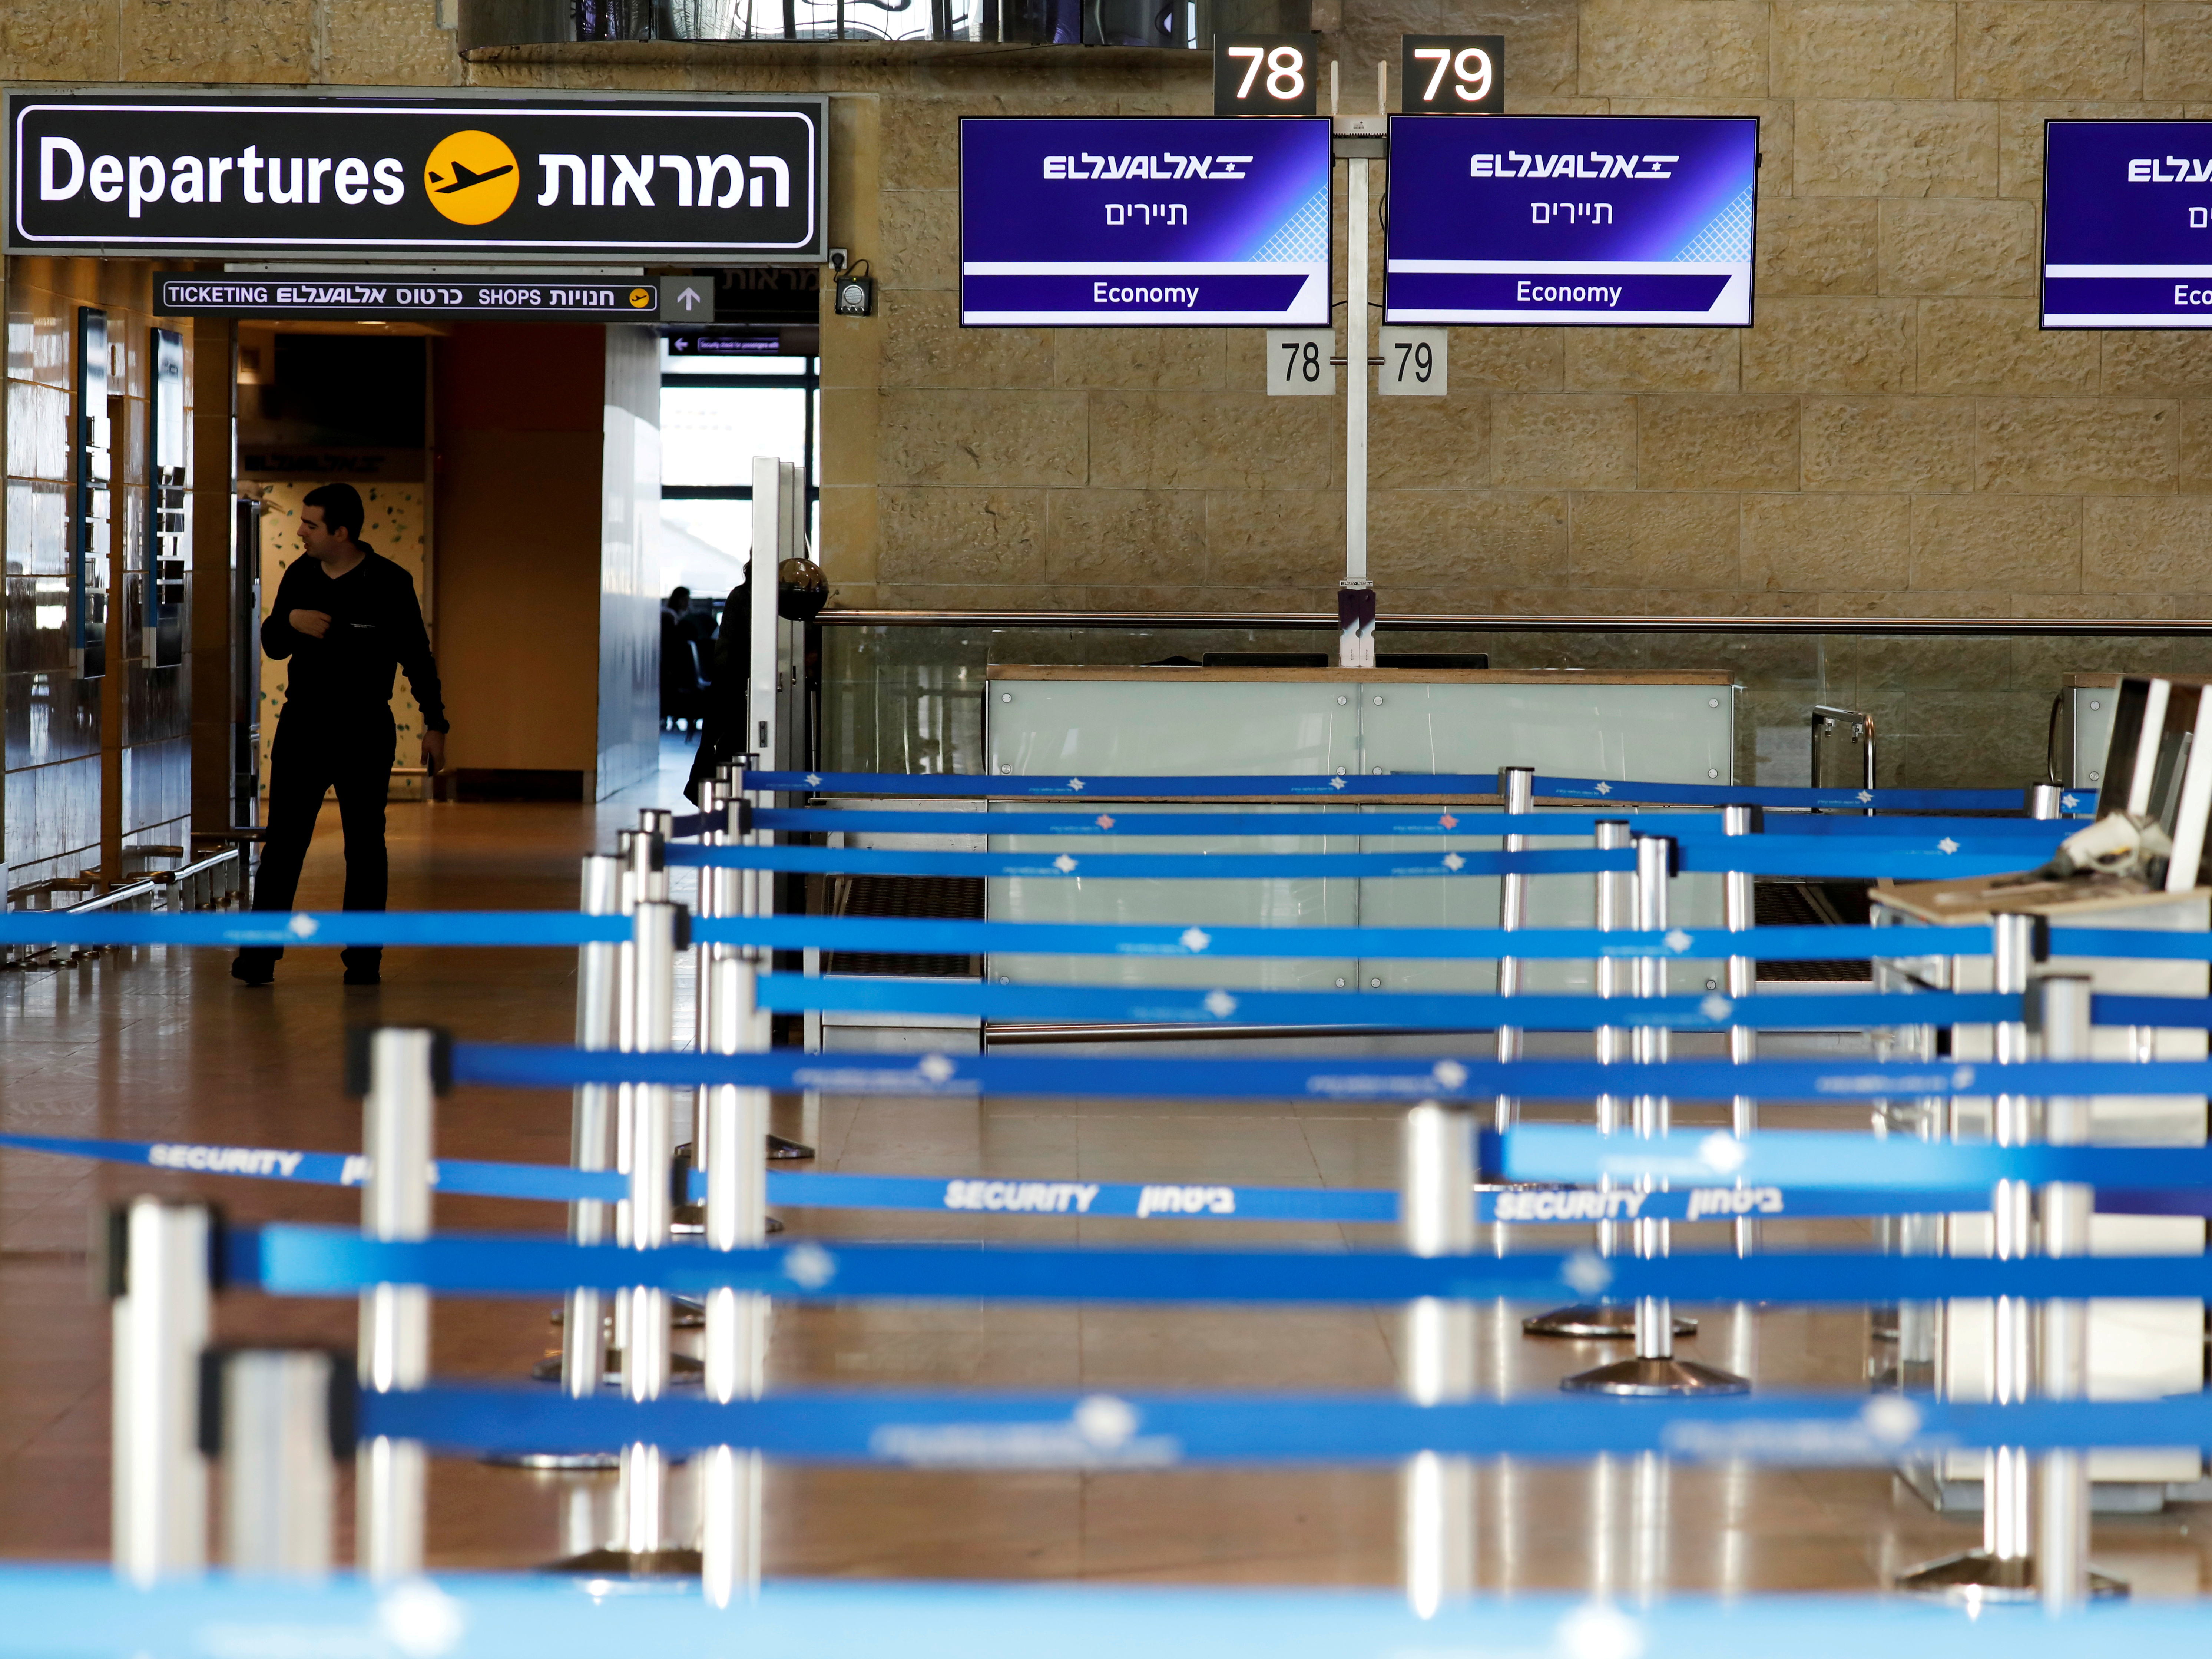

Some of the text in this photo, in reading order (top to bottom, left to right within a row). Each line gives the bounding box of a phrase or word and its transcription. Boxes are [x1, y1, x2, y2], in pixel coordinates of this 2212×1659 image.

[1229, 46, 1304, 99] 78
[1414, 48, 1492, 101] 79
[40, 137, 790, 218] Departures המראות
[1105, 204, 1188, 225] תיירים
[1531, 202, 1613, 224] תיירים
[168, 287, 268, 303] TICKETING
[396, 287, 463, 305] כרטוס
[478, 289, 542, 305] SHOPS
[549, 290, 615, 305] חנויות
[1094, 282, 1199, 307] Economy
[1517, 281, 1622, 307] Economy
[1282, 342, 1320, 382] 78
[1395, 342, 1433, 383] 79
[149, 1143, 302, 1177] SECURITY
[944, 1179, 1236, 1219] SECURITY ביטחון
[1494, 1187, 1784, 1222] SECURITY ביטחון
